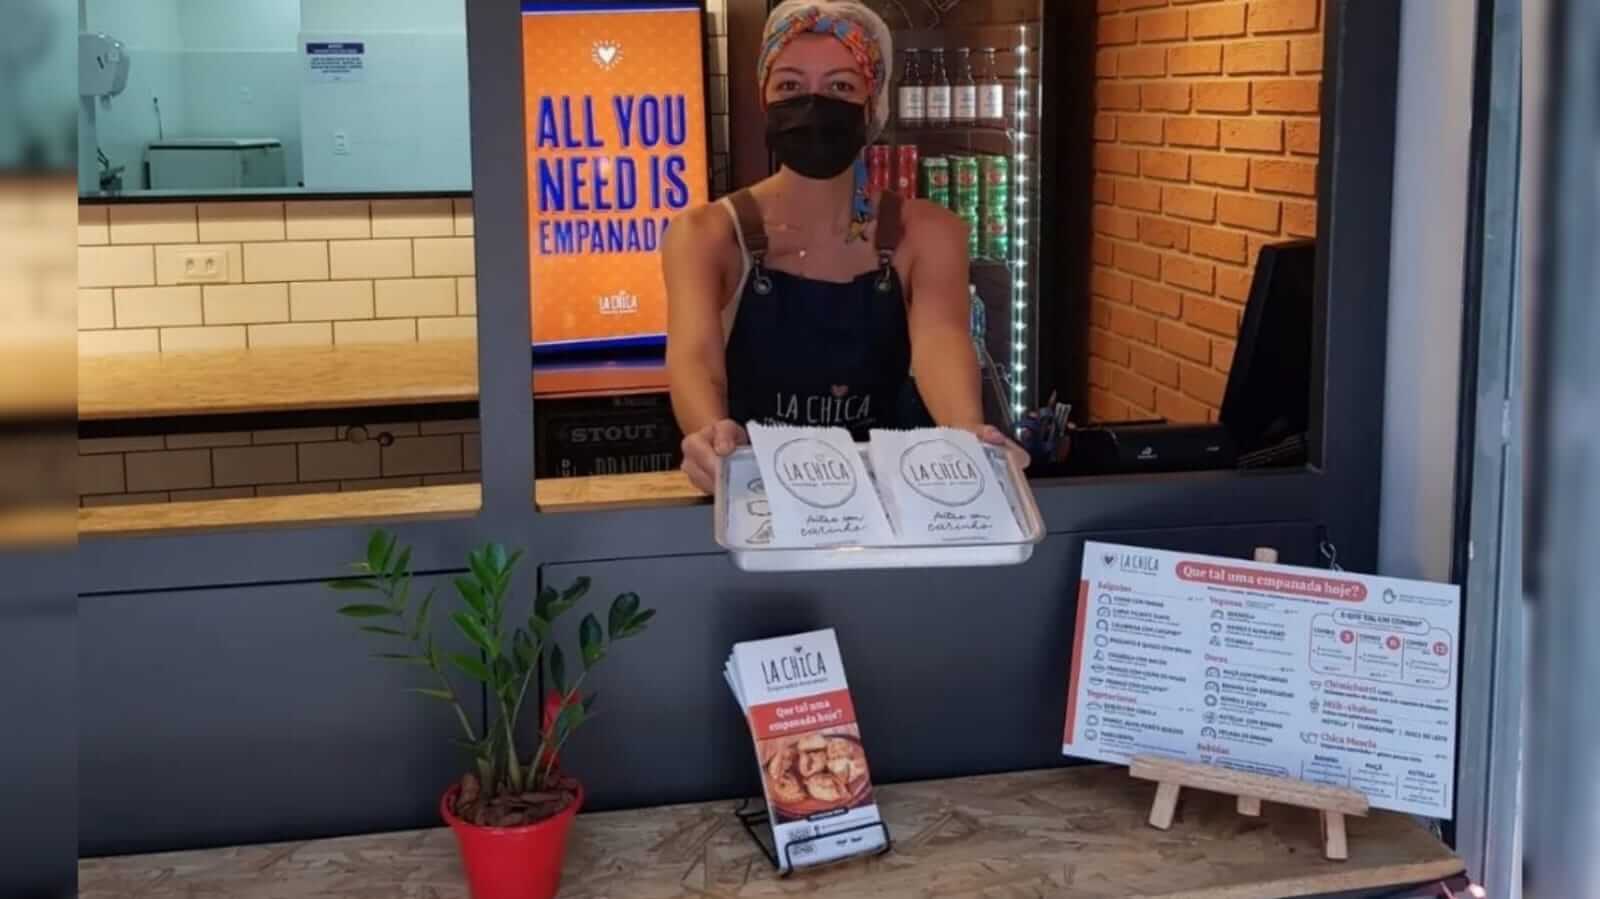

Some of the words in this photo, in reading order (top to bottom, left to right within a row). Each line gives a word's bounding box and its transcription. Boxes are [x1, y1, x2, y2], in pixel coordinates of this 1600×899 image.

[537, 94, 604, 148] ALL
[612, 93, 686, 147] YOU
[537, 156, 638, 212] NEED
[651, 154, 689, 209] IS
[776, 392, 799, 420] LA
[806, 394, 871, 424] CHICA
[570, 424, 656, 443] STOUT
[784, 462, 804, 481] LA
[805, 461, 850, 481] CHICA
[910, 463, 930, 481] LA
[931, 460, 977, 480] CHICA
[1184, 564, 1206, 578] Que
[1208, 567, 1225, 581] tal
[1227, 572, 1254, 585] uma
[1256, 575, 1321, 592] empanada
[1324, 581, 1360, 597] hoje?
[761, 659, 781, 685] LA
[782, 651, 827, 682] CHICA
[768, 714, 817, 732] empanada
[817, 710, 843, 725] hoje?
[776, 705, 794, 719] Que
[795, 702, 810, 716] tal
[810, 701, 831, 712] uma
